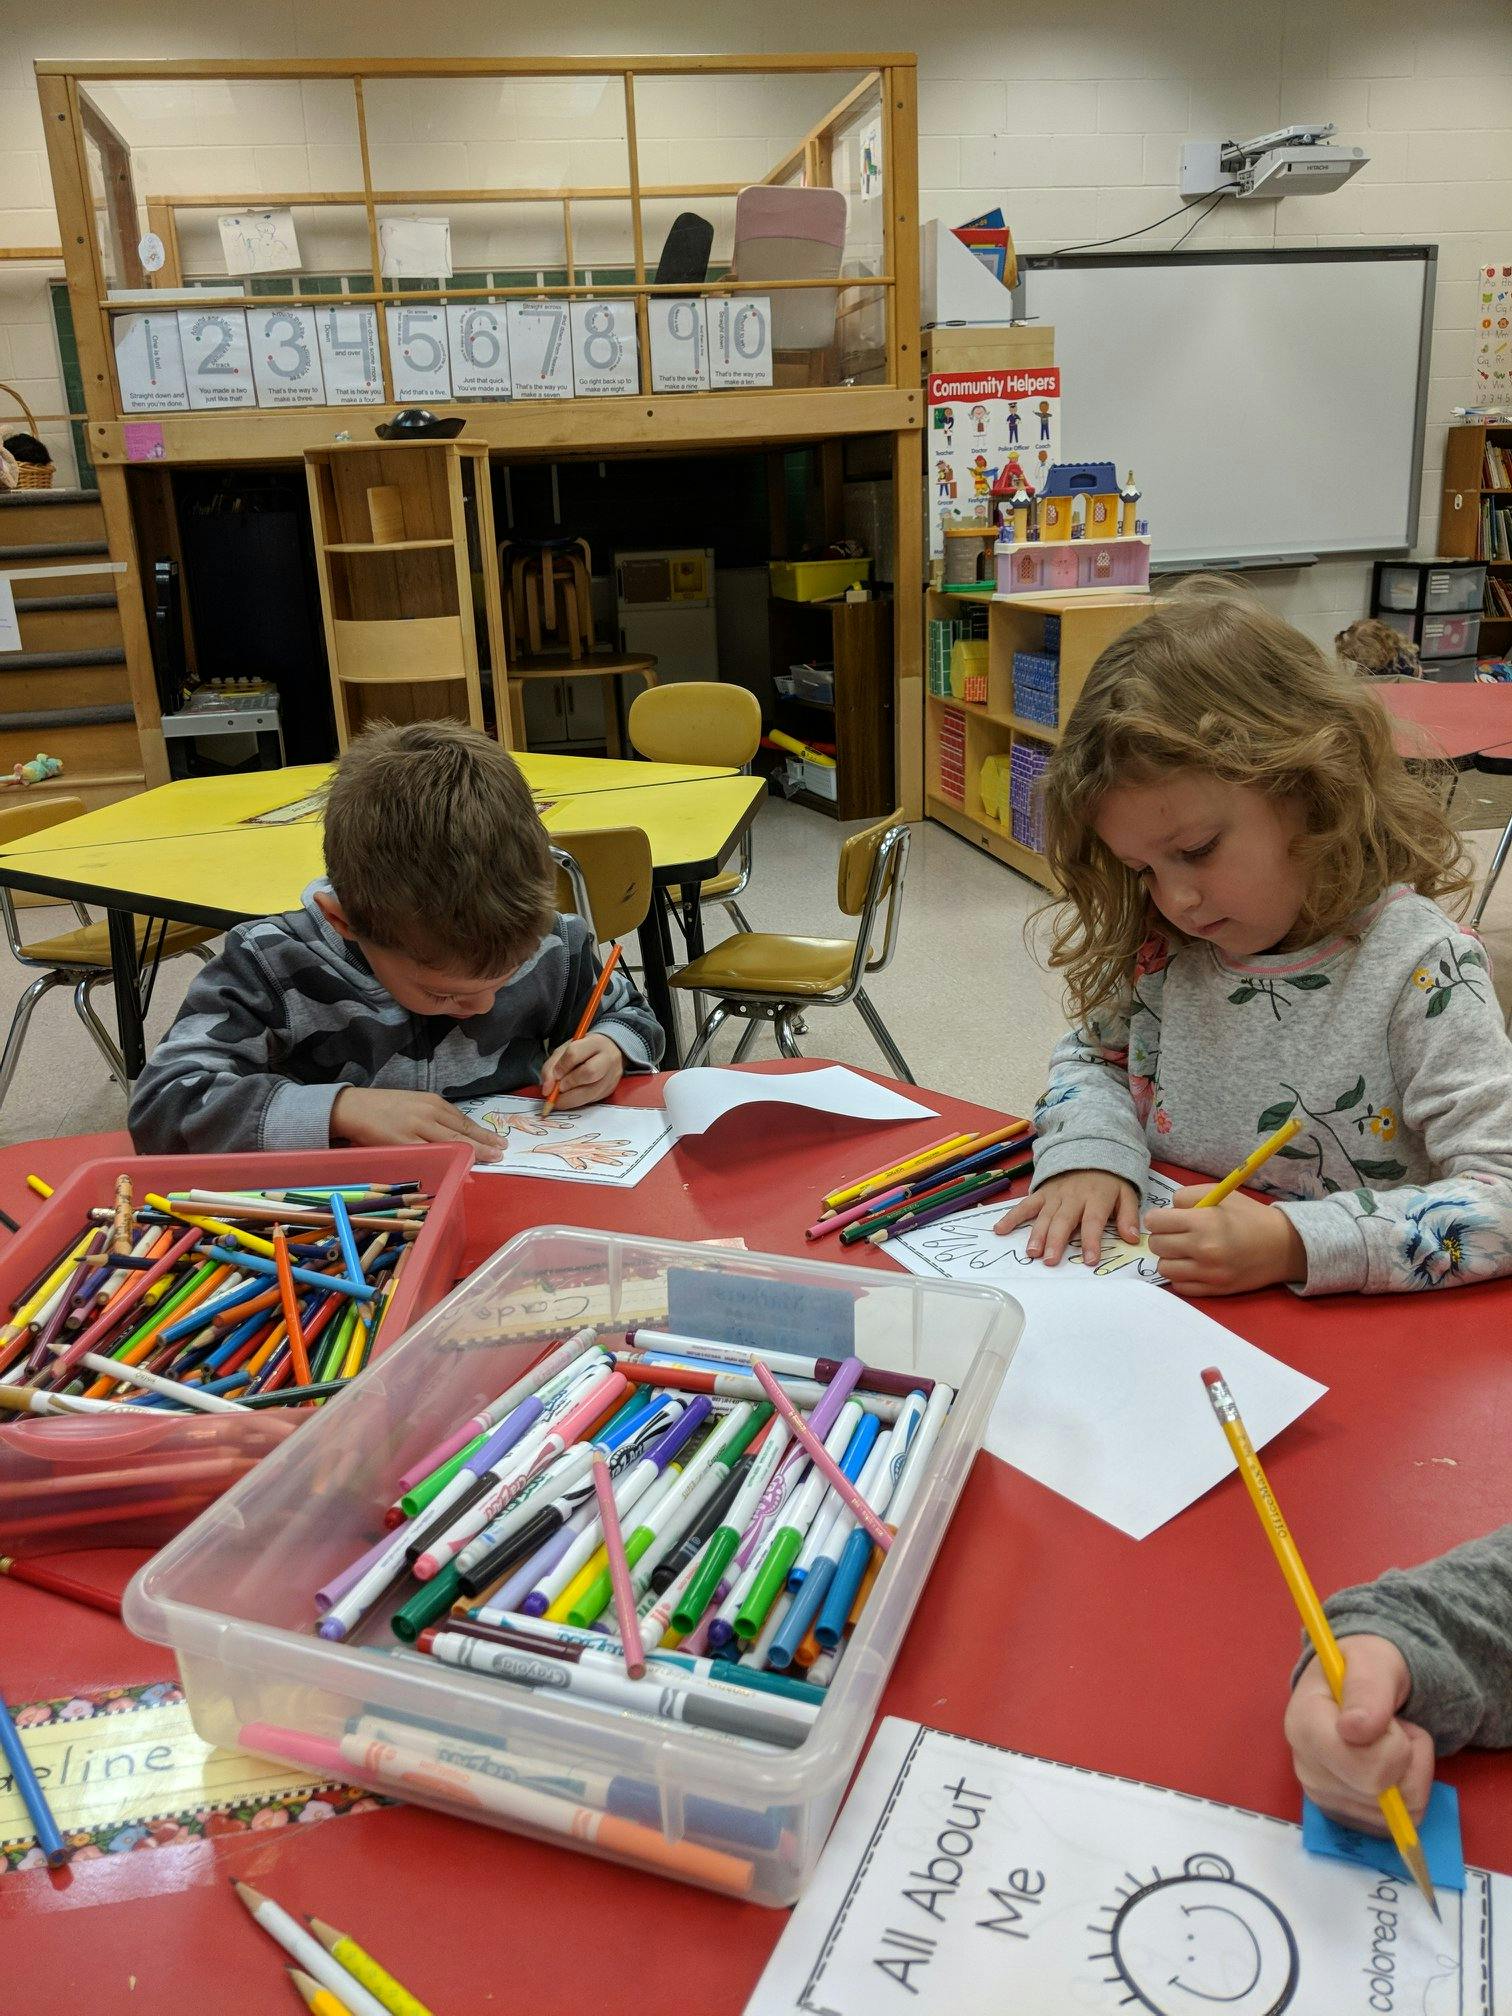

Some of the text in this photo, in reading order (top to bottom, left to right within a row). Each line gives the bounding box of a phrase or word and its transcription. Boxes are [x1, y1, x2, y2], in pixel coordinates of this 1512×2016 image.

[366, 328, 375, 346] down
[368, 347, 376, 364] some
[129, 393, 154, 401] Straight
[933, 374, 1056, 398] Community Helpers
[497, 1652, 569, 1688] Crayola
[0, 1745, 174, 1793] eline
[872, 1775, 993, 1995] All About
[975, 1864, 1046, 1940] Me
[1362, 1869, 1407, 2013] colored by
